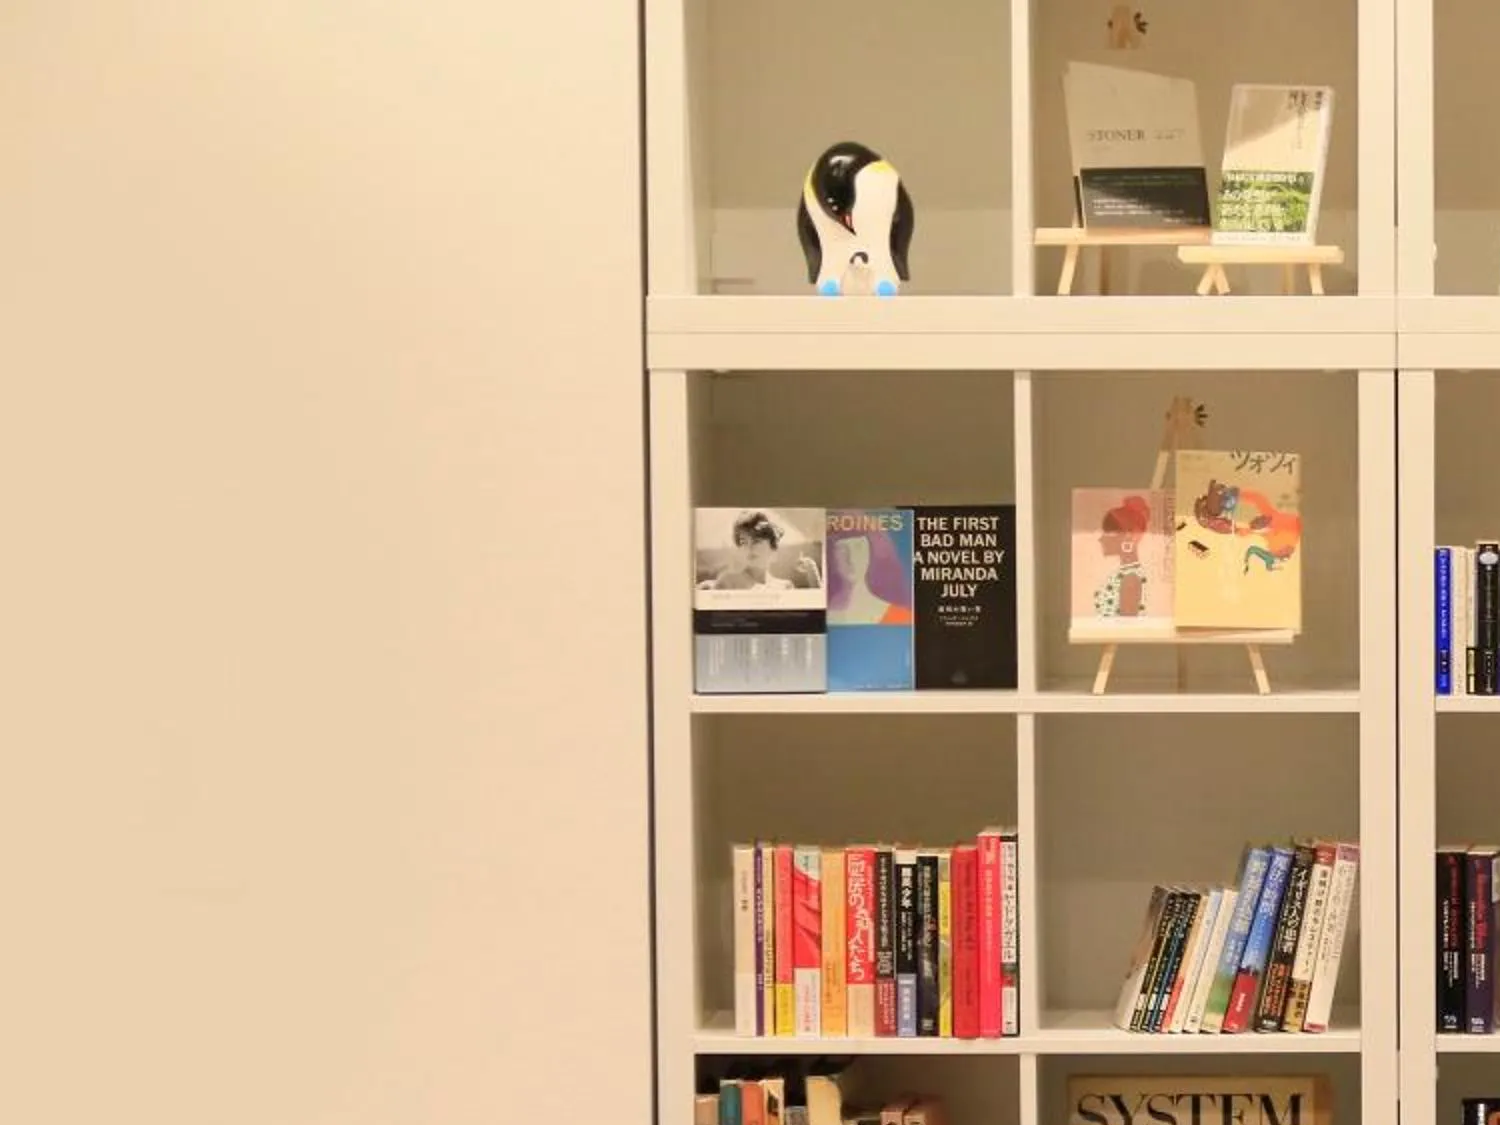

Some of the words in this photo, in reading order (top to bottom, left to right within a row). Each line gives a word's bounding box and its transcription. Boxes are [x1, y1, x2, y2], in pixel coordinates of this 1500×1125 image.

[1086, 128, 1145, 142] STONER
[917, 516, 947, 531] THE
[953, 516, 999, 531] FIRST
[920, 533, 954, 548] BAD
[960, 533, 997, 548] MAN
[914, 551, 924, 565] A
[927, 550, 981, 565] NOVEL
[984, 550, 1005, 565] BY
[920, 567, 999, 581] MIRANDA
[940, 584, 978, 598] JULY
